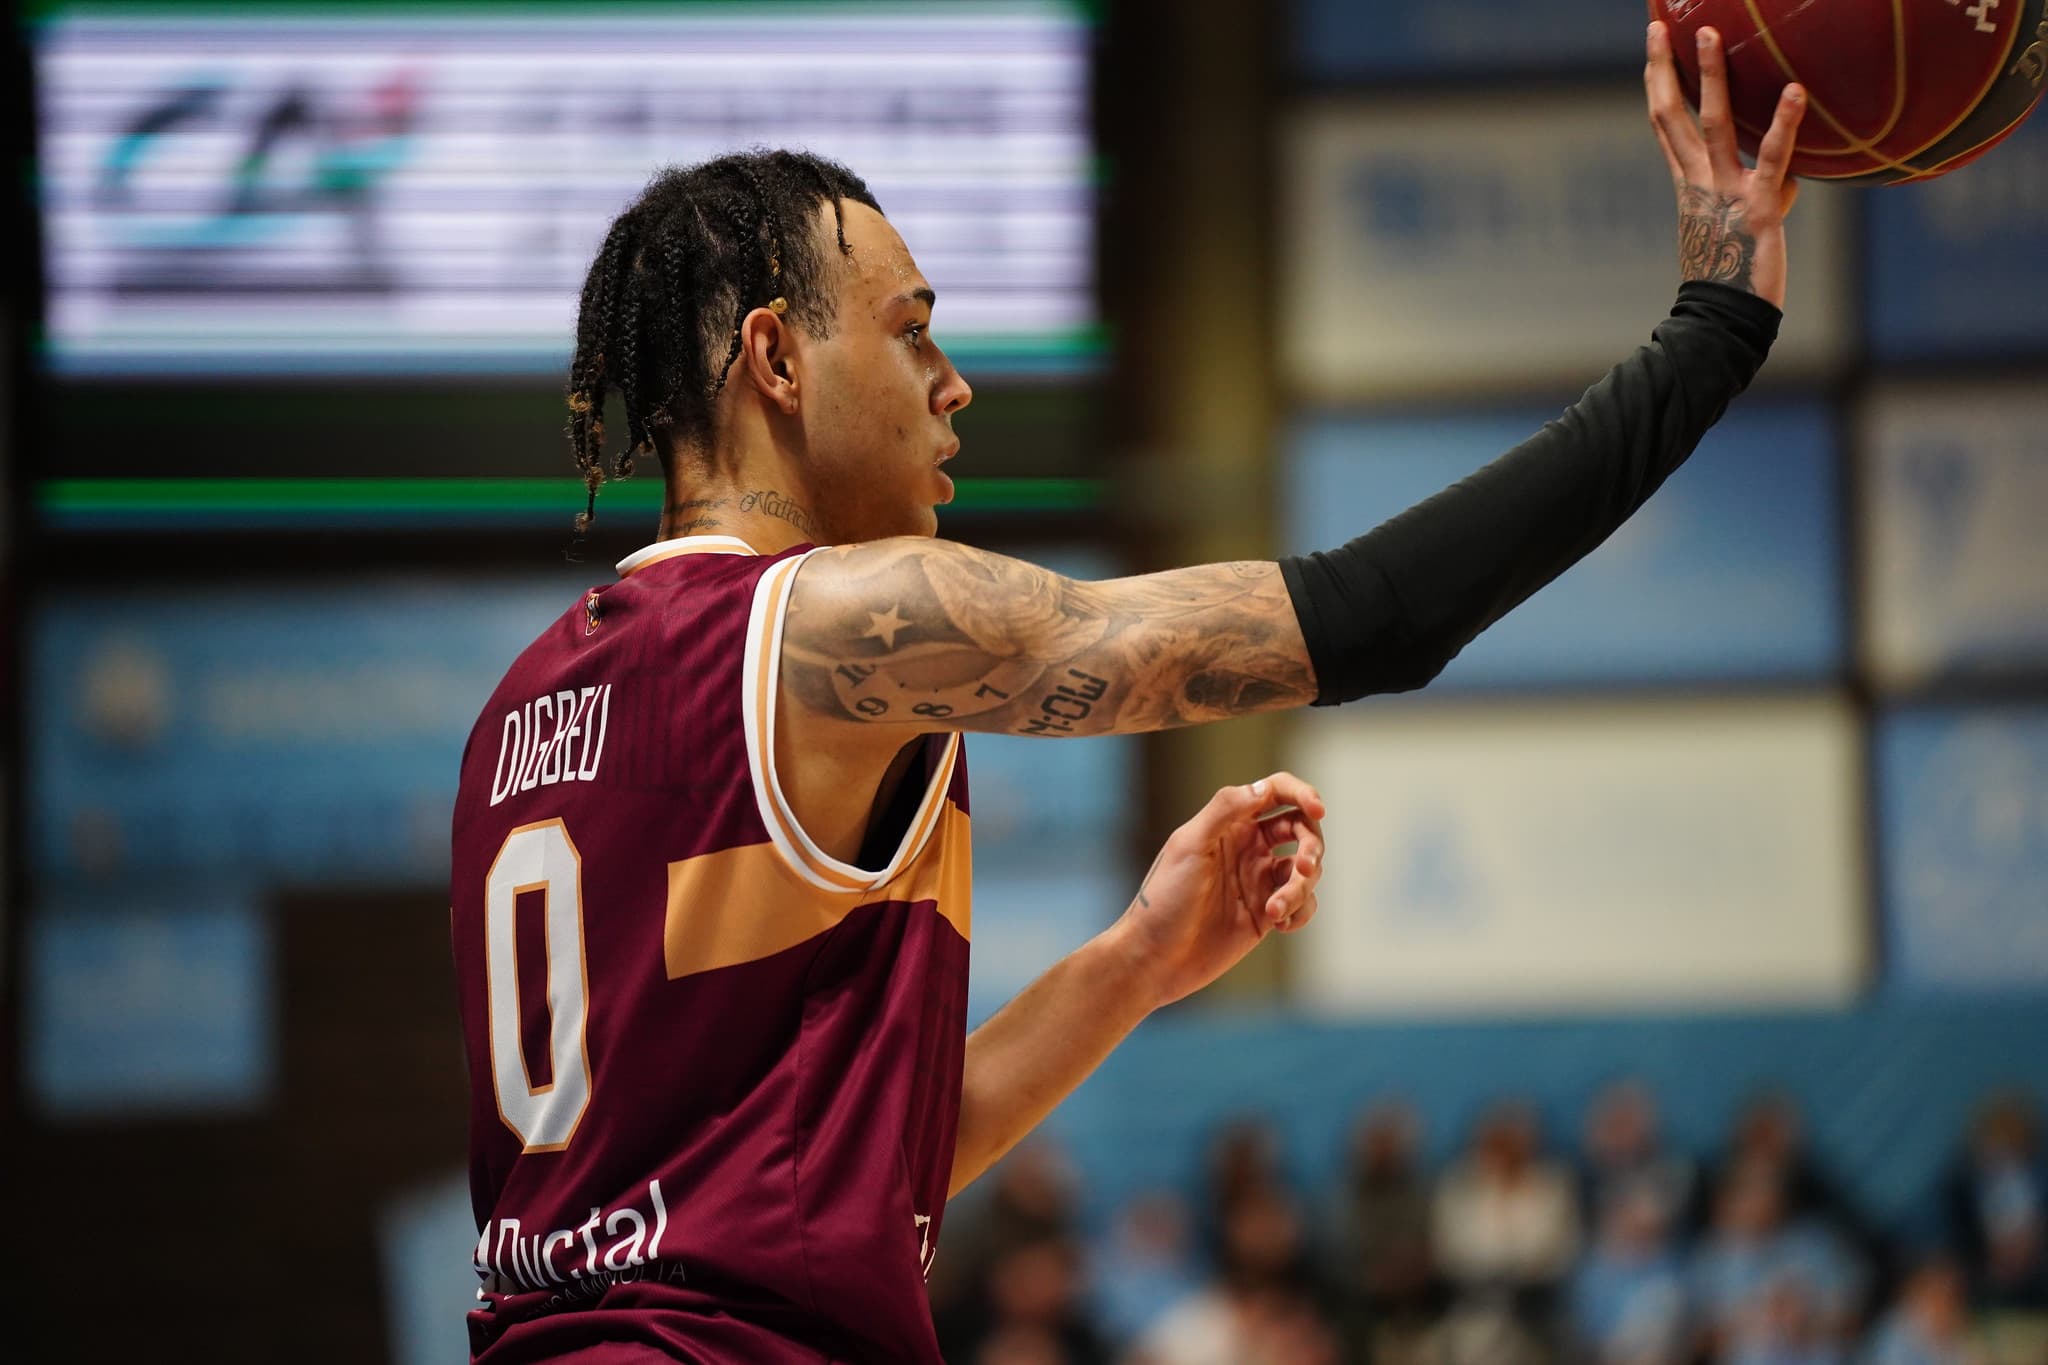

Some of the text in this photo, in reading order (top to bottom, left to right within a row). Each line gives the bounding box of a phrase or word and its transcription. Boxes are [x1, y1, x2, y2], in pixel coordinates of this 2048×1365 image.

[974, 683, 1009, 699] 7
[855, 697, 889, 716] 9
[911, 703, 953, 718] 8
[489, 683, 612, 808] DIGBEU
[485, 816, 592, 1155] 0
